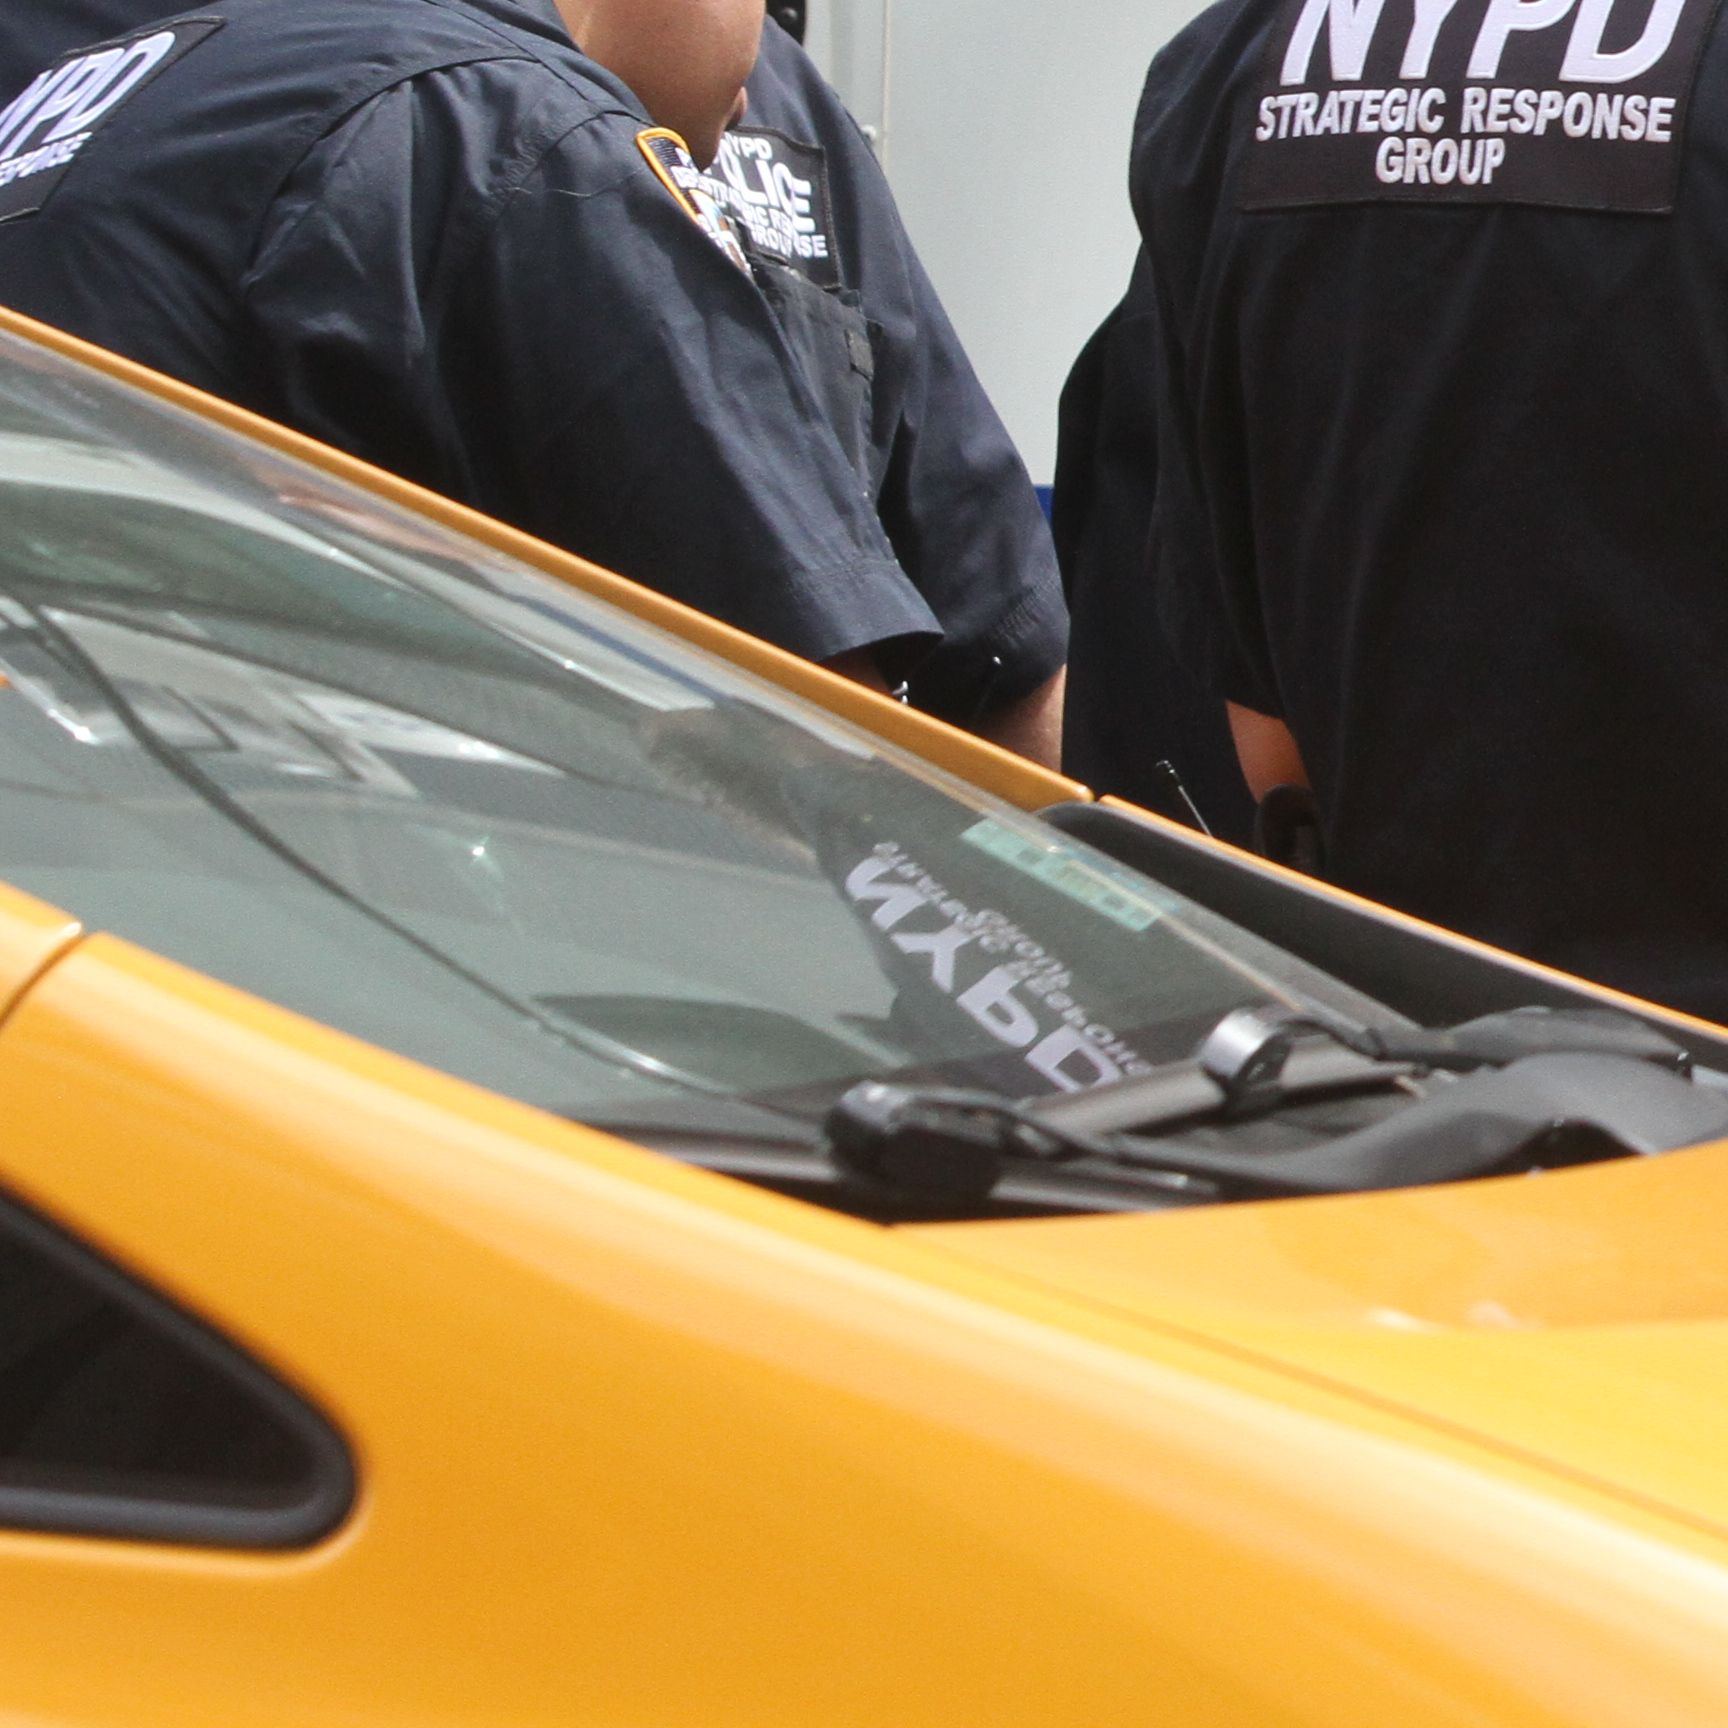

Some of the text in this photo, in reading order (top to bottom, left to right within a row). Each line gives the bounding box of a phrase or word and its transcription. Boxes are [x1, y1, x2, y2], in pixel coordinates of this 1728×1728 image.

[0, 31, 176, 162] YPD
[1255, 87, 1676, 142] STRATEGIC RESPONSE
[703, 138, 816, 233] OLICE
[1375, 137, 1506, 185] GROUP
